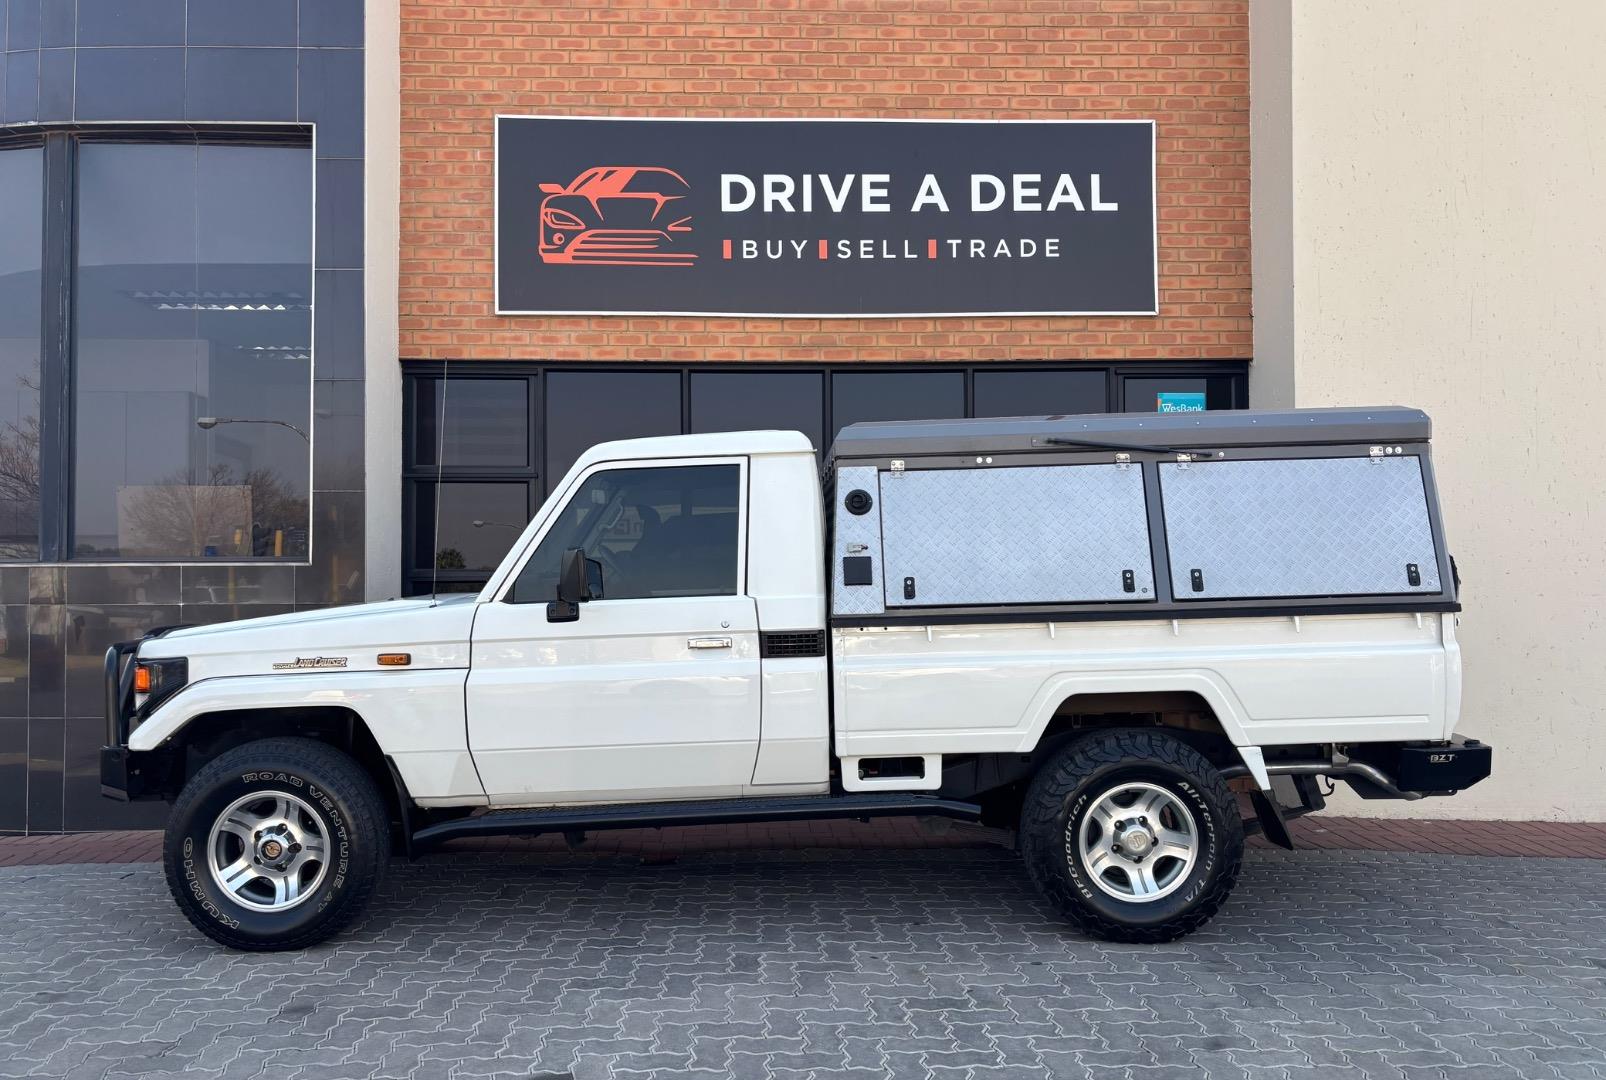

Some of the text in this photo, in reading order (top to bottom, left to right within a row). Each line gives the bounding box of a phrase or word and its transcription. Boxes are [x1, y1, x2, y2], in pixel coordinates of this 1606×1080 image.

[720, 173, 1119, 213] DRIVE A DEAL
[742, 238, 1060, 260] BUY SELL TRADE
[1162, 403, 1203, 413] WesBank
[242, 772, 303, 788] ROAD
[309, 785, 349, 889] VENTURE
[1065, 794, 1093, 899] BFGoodrich
[1178, 781, 1216, 871] All-Terrain
[183, 837, 240, 930] KUMHO
